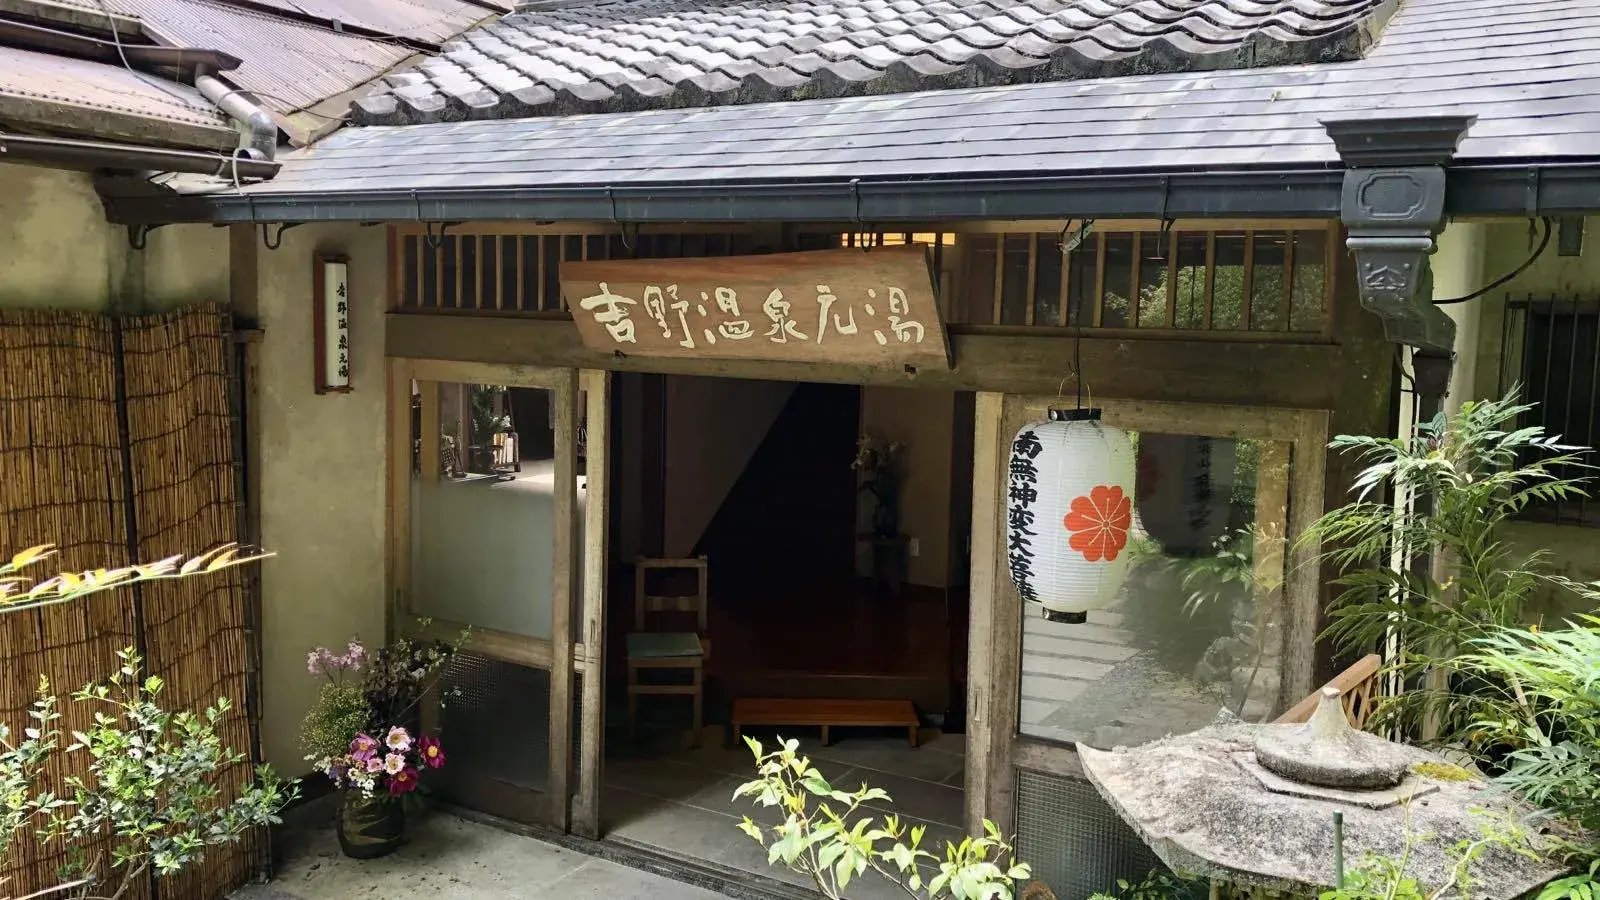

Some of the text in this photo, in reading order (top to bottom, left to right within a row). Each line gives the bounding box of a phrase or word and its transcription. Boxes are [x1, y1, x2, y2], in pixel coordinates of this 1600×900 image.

[336, 282, 348, 378] 吉野温泉元湯
[580, 281, 925, 349] 吉野温泉元湯
